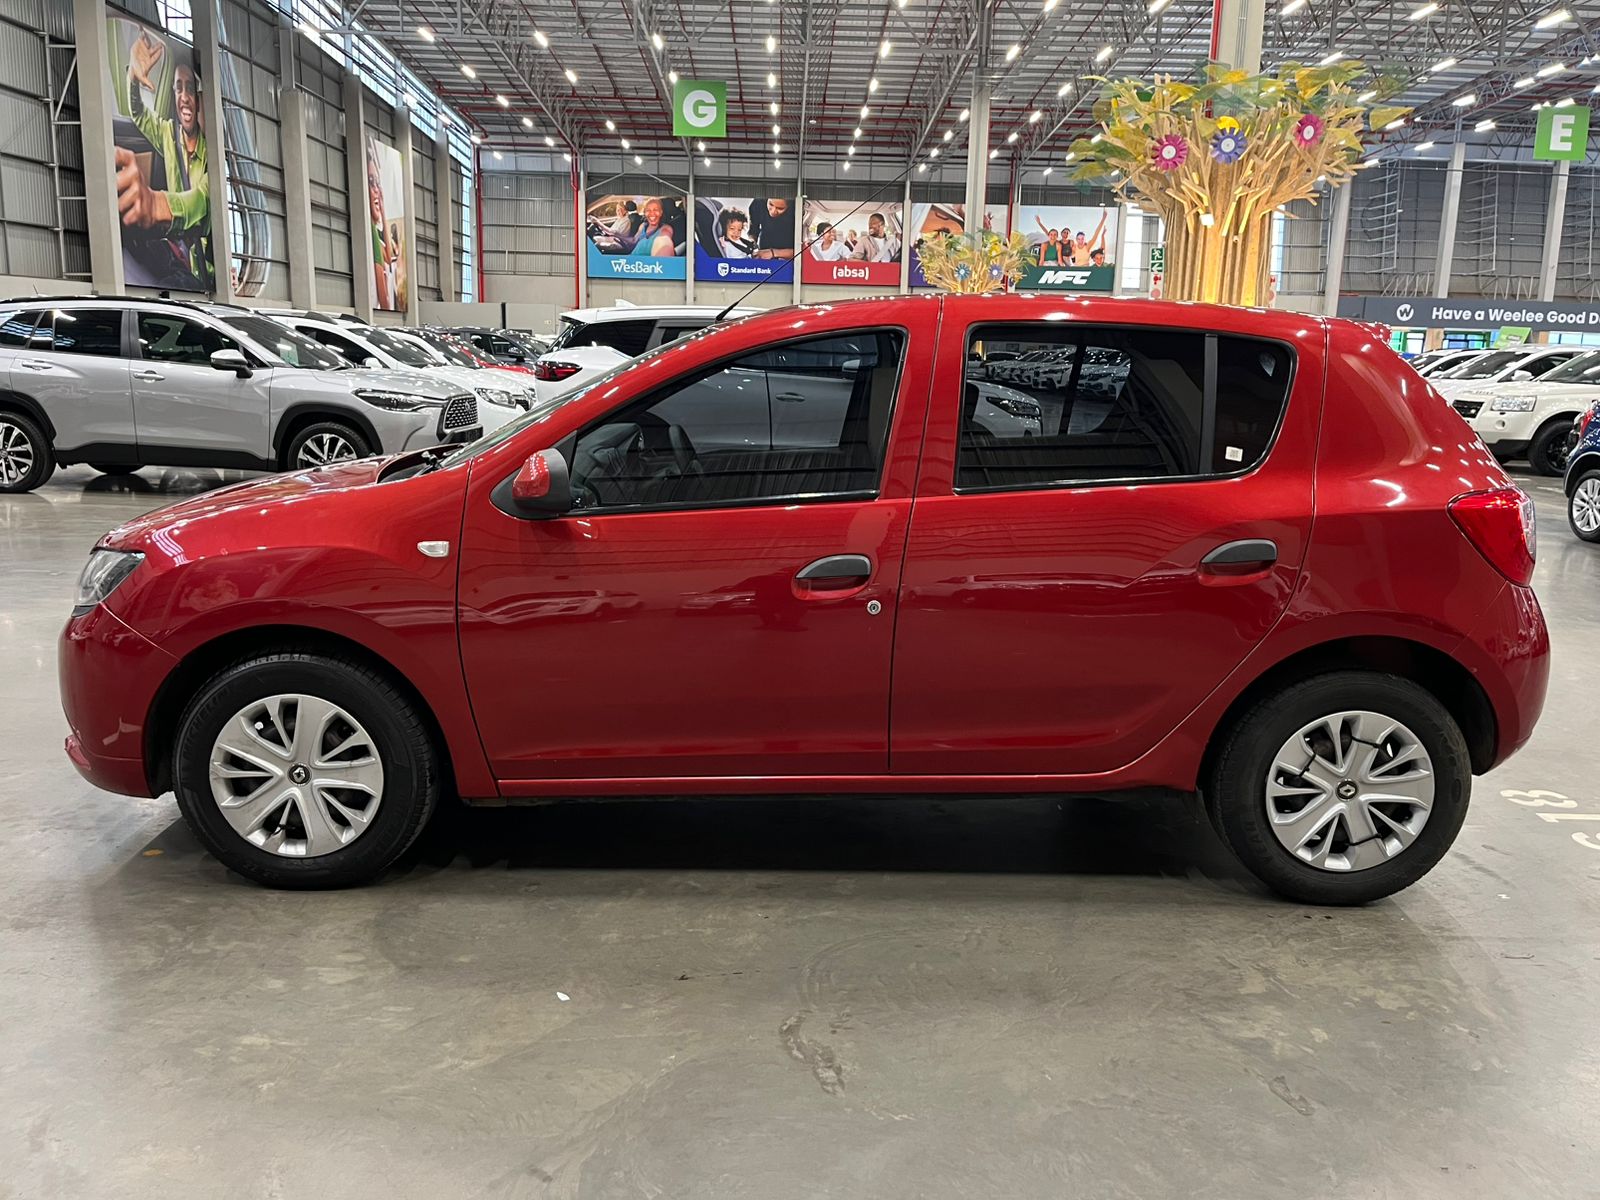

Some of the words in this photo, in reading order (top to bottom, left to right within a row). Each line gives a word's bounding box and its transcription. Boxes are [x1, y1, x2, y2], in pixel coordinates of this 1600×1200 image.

[683, 90, 717, 128] G
[1549, 115, 1576, 151] E
[611, 258, 664, 274] WesBank
[730, 266, 756, 275] Standard
[756, 266, 772, 275] Bank
[1038, 270, 1092, 285] MFC
[1431, 306, 1472, 321] Have
[1474, 310, 1485, 321] a
[1488, 308, 1544, 323] Weelee
[1546, 311, 1587, 325] Good
